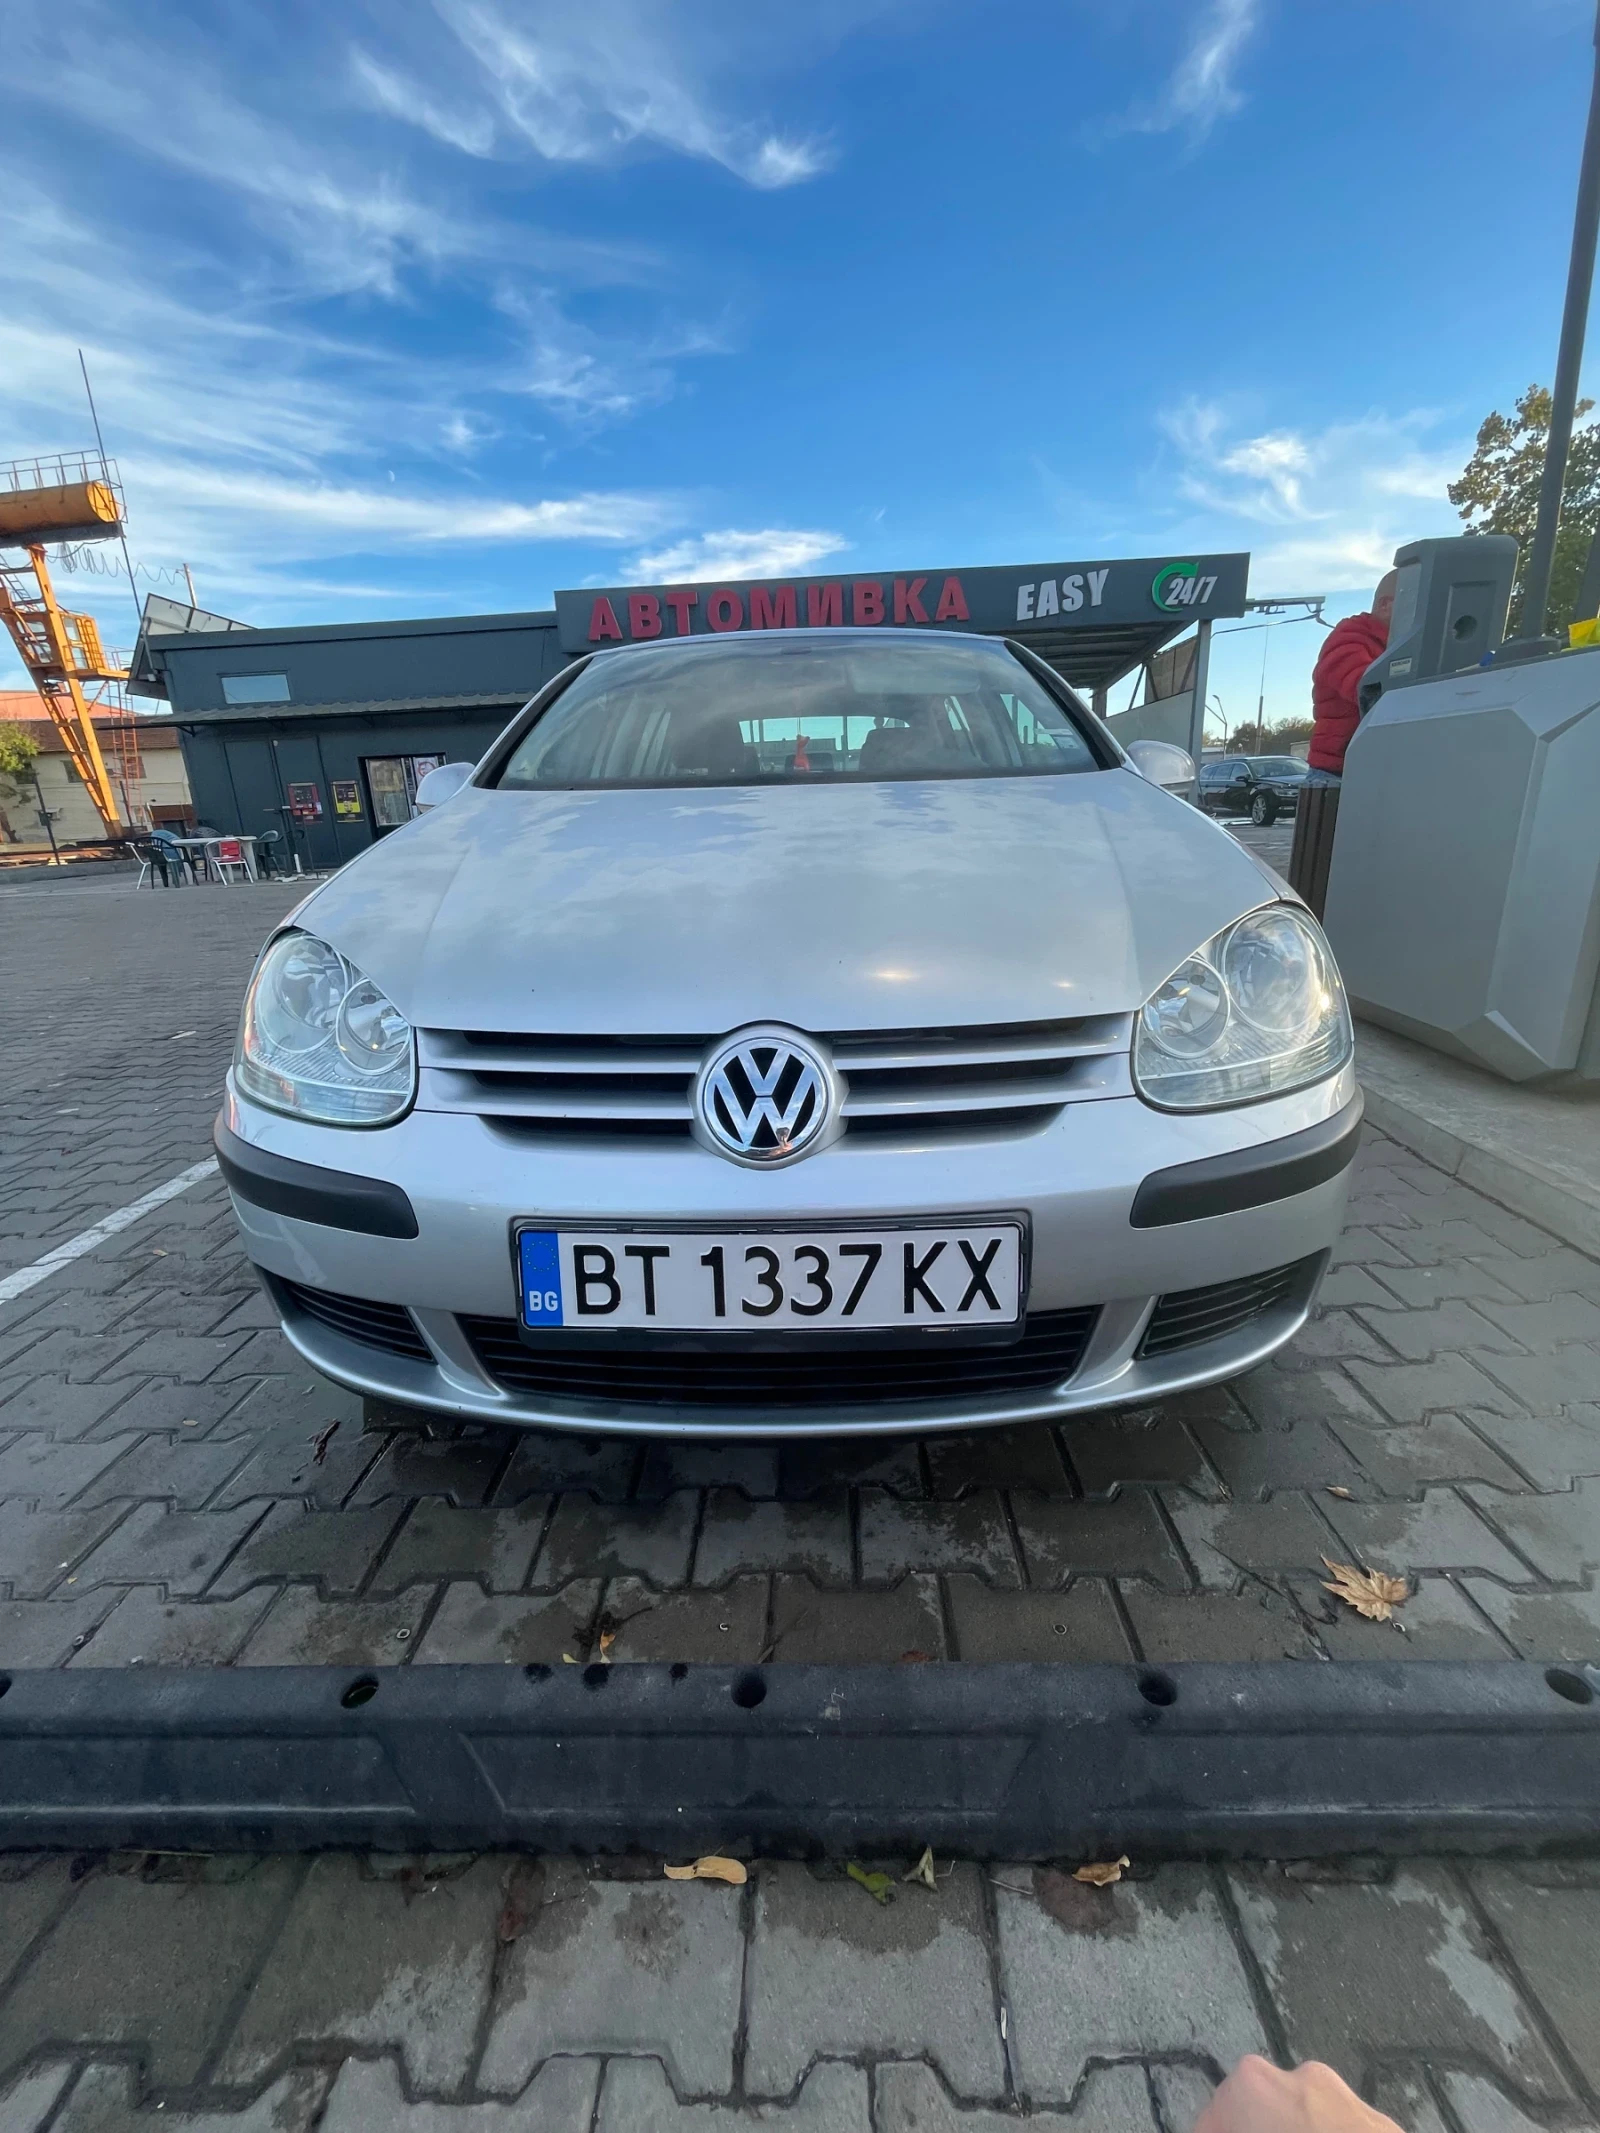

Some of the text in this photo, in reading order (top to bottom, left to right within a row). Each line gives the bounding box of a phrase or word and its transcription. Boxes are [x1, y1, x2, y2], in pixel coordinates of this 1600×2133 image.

[588, 576, 970, 641] АВТОМИВКА
[1016, 568, 1110, 621] EASY
[1165, 575, 1218, 606] 24/7
[529, 1290, 558, 1312] BG
[573, 1238, 1002, 1317] BT 1337 KX
